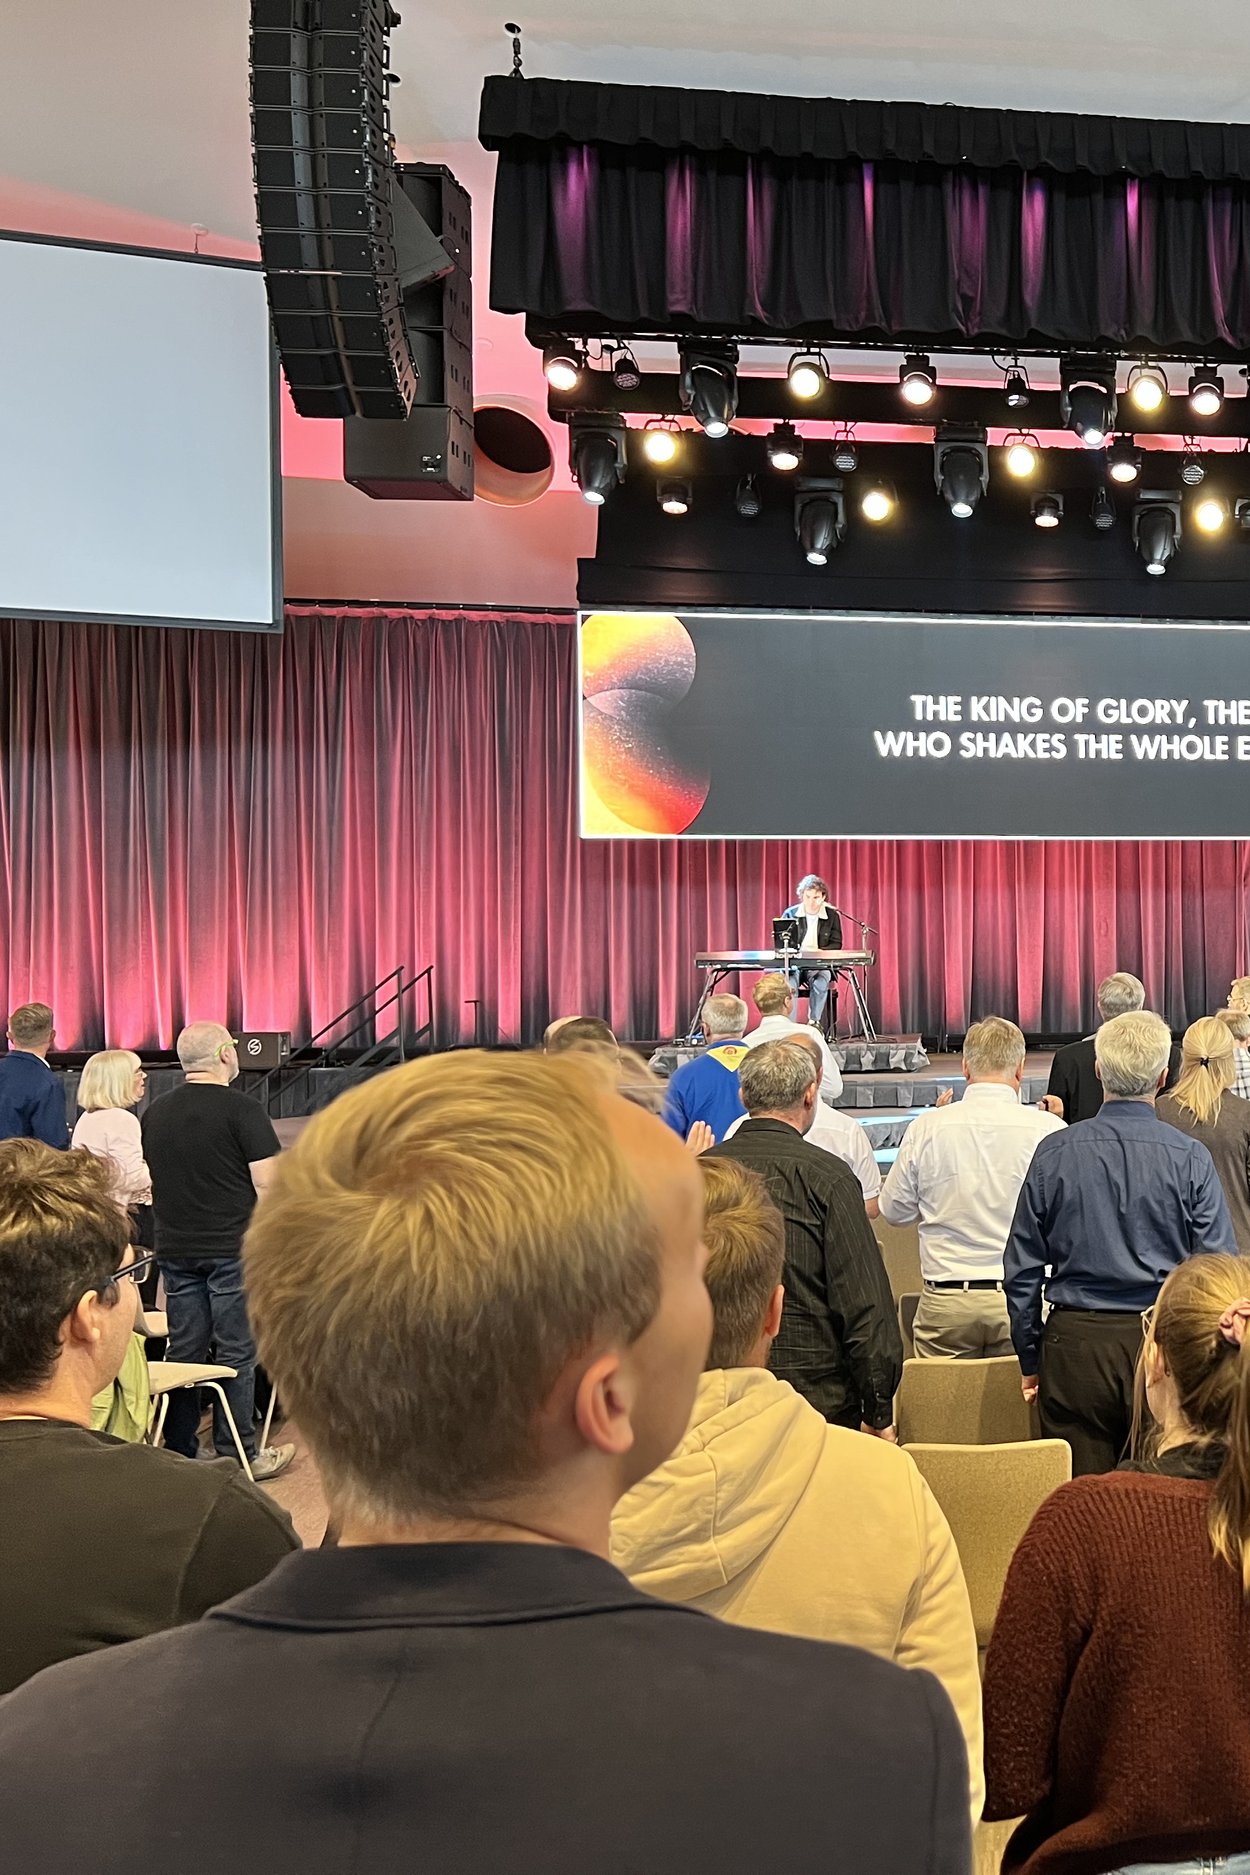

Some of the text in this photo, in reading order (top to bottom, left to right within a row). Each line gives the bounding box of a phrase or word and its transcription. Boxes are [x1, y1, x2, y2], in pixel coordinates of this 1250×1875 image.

[909, 694, 963, 722] THE
[969, 695, 1044, 724] KING
[1049, 696, 1090, 724] OF
[1096, 697, 1197, 728] GLORY,
[873, 730, 952, 759] WHO
[958, 731, 1068, 760] SHAKES
[1072, 733, 1124, 761] THE
[1129, 733, 1230, 761] WHOLE
